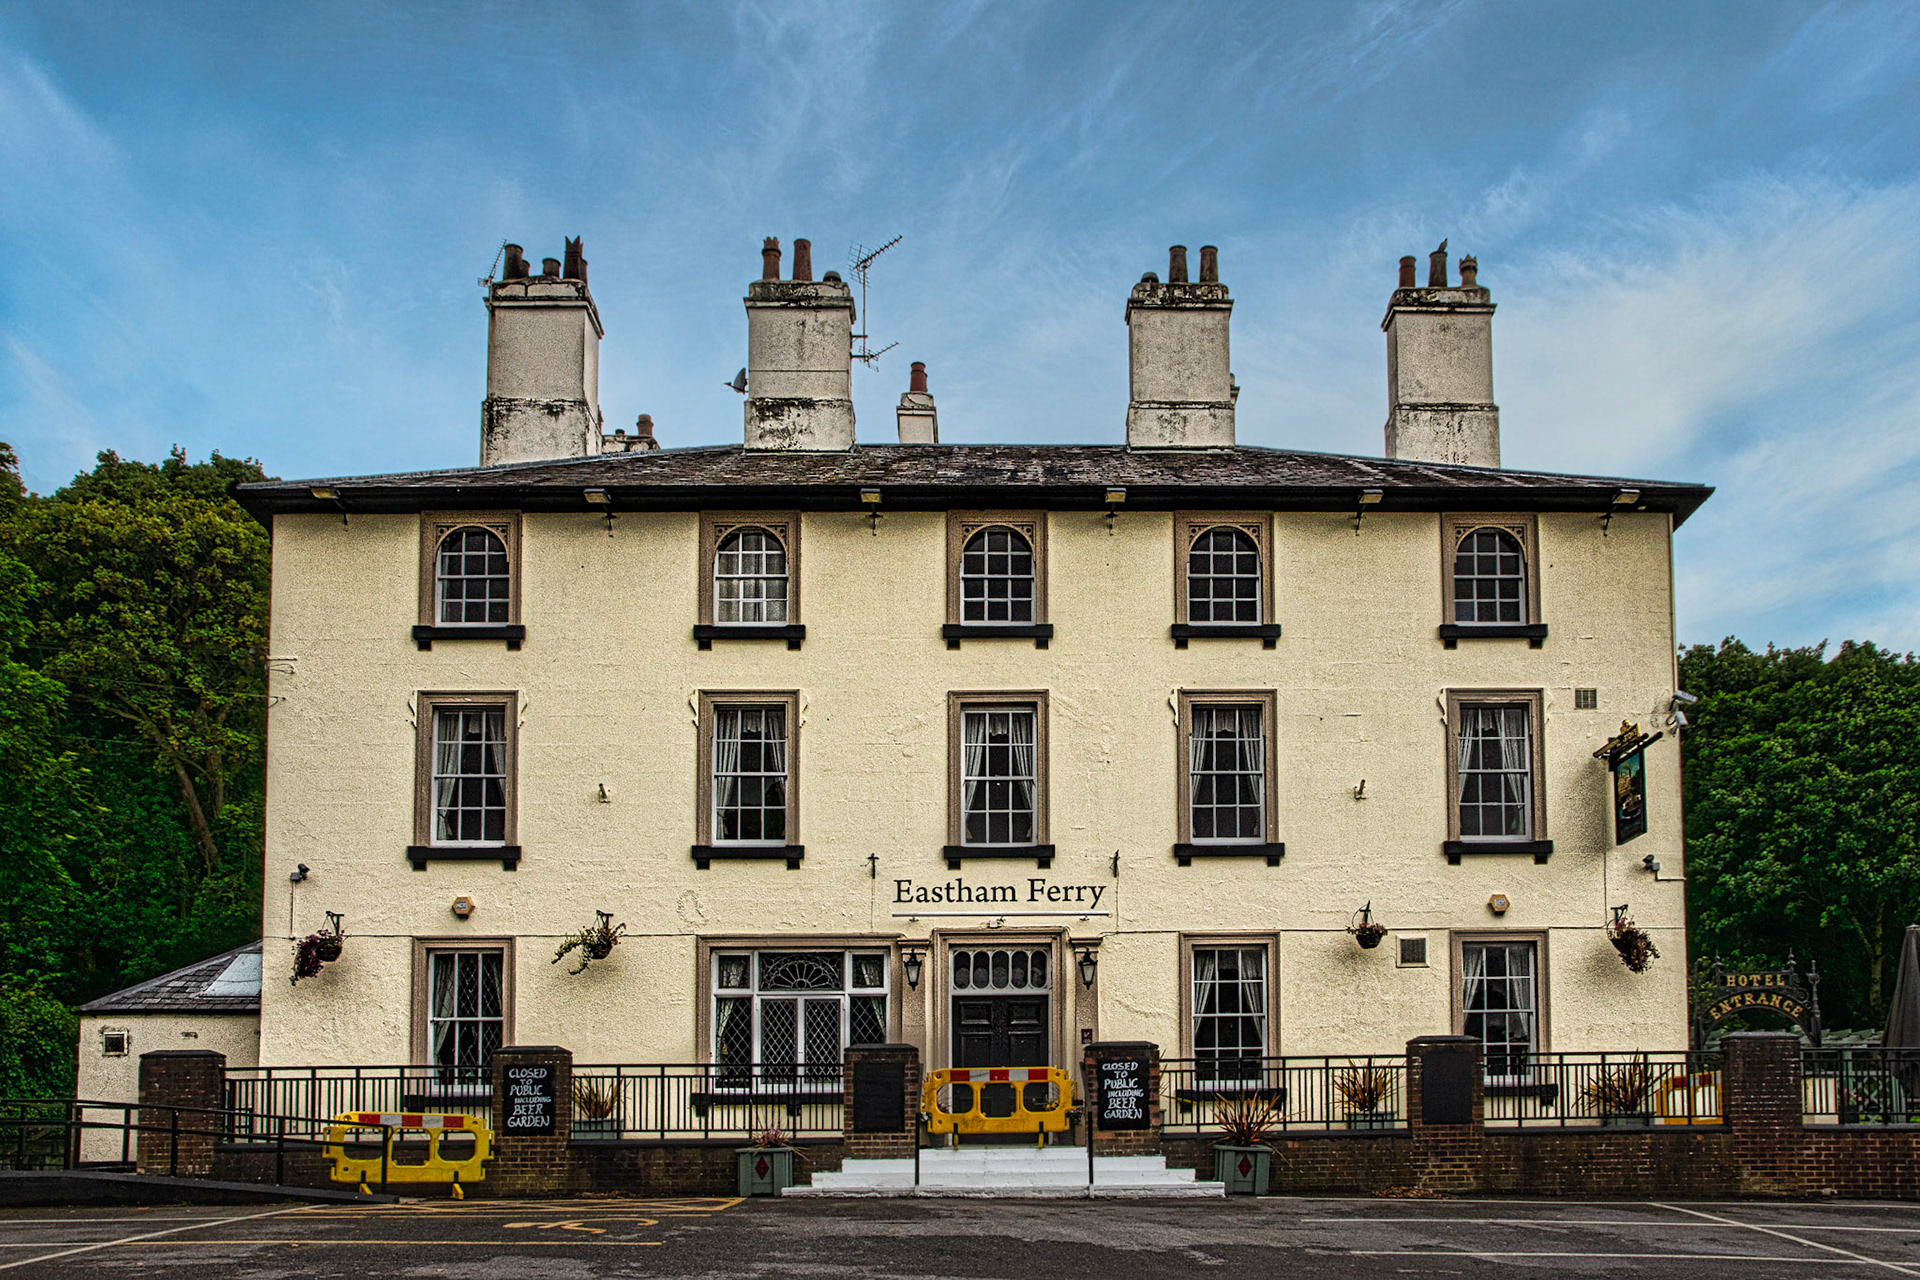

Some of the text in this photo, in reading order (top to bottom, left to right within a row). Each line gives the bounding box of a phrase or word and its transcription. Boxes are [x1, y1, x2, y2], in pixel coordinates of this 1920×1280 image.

[893, 878, 1106, 909] Eastham Ferry
[1726, 974, 1785, 987] HOTEL
[1709, 992, 1803, 1020] ENTRANCE
[1102, 1061, 1139, 1071] CLOSED
[508, 1068, 548, 1079] CLOSED
[1113, 1070, 1128, 1079] TO
[509, 1084, 543, 1096] PUBLIC
[1103, 1078, 1139, 1090] PUBLIC
[1107, 1089, 1144, 1098] INCLUDING
[514, 1096, 552, 1104] INCLUDING
[1108, 1097, 1137, 1109] BEER
[512, 1103, 543, 1116] BEER
[1103, 1108, 1142, 1119] GARDEN
[507, 1115, 550, 1127] GARDEN
